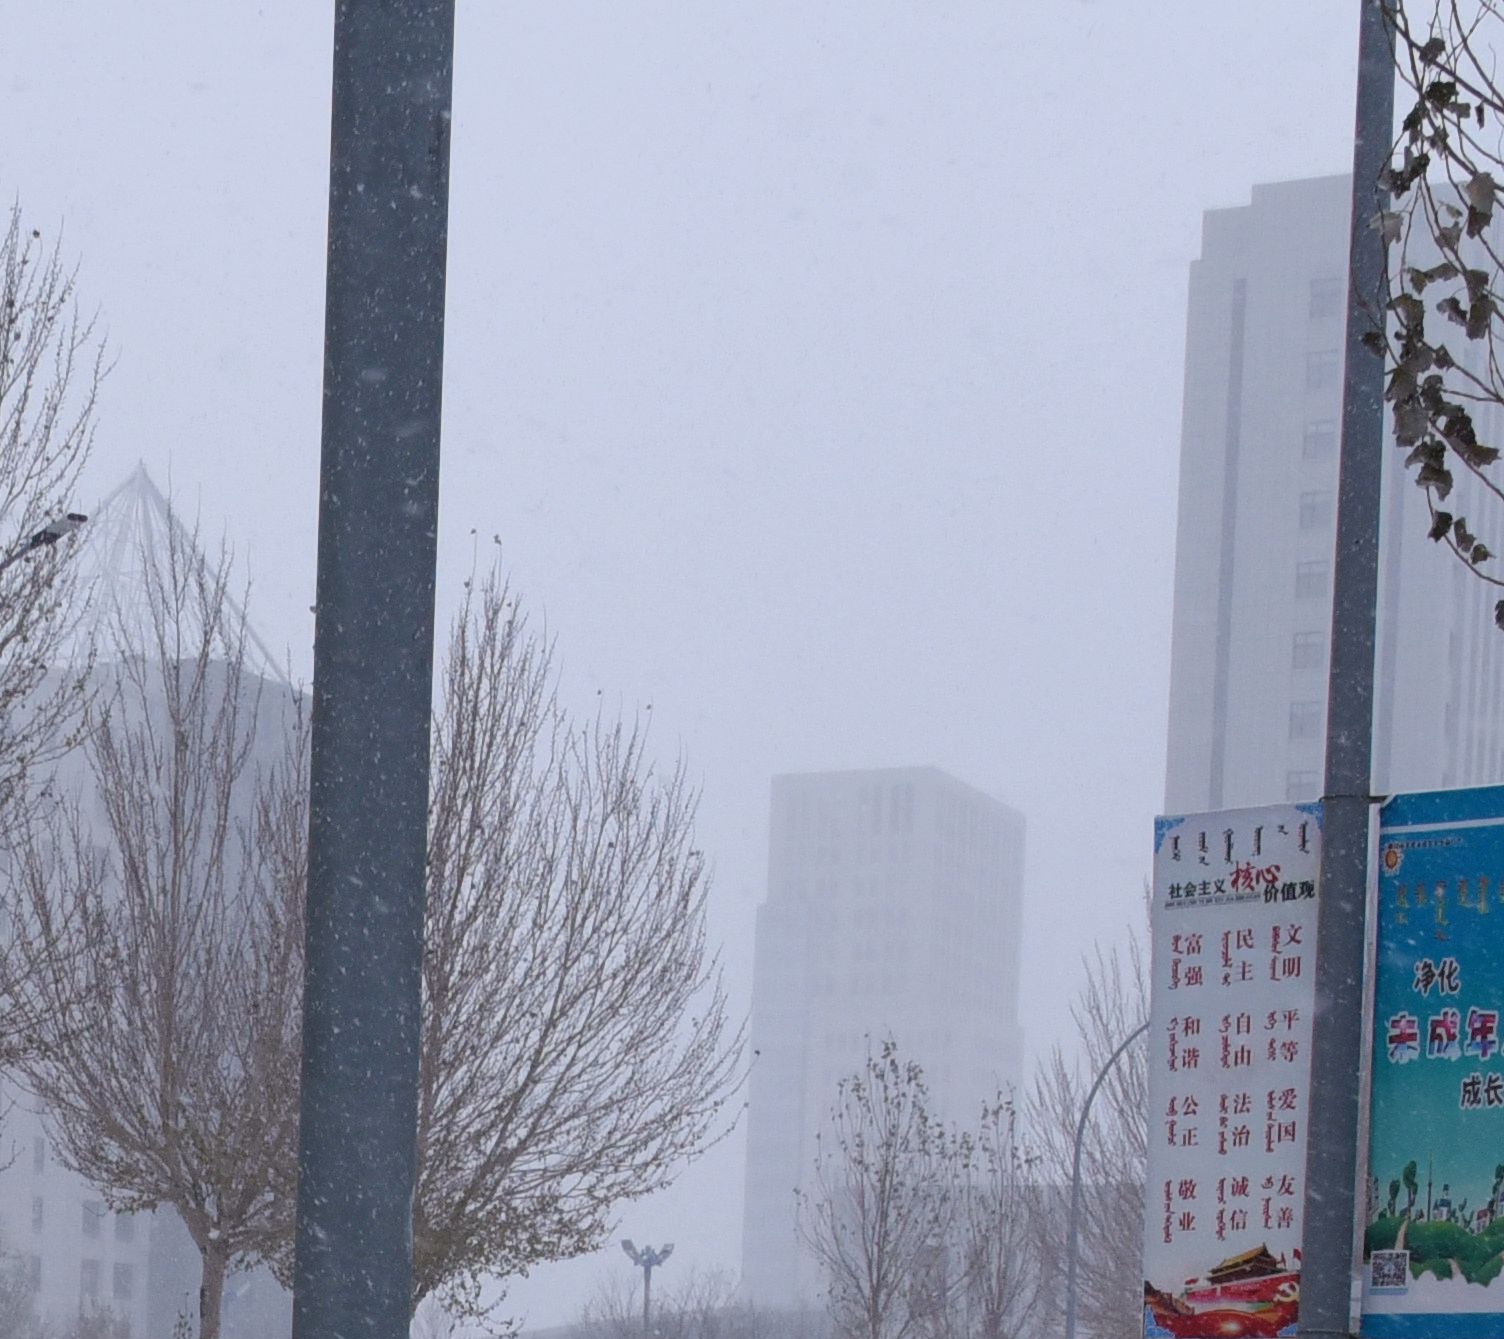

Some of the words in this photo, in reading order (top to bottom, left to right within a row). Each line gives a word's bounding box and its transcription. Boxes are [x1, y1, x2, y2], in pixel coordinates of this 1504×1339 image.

[1185, 934, 1203, 986] 富强
[1235, 928, 1254, 982] 民主
[1283, 924, 1302, 978] 文明
[1414, 958, 1460, 996] 净化
[1182, 1016, 1200, 1069] 和谐
[1234, 1013, 1251, 1067] 自由
[1281, 1008, 1300, 1063] 平等
[1181, 1095, 1199, 1147] 公正
[1233, 1093, 1252, 1147] 法治
[1278, 1088, 1297, 1143] 爱国
[1178, 1179, 1196, 1231] 敬业
[1231, 1176, 1249, 1231] 诚信
[1277, 1174, 1295, 1229] 友善
